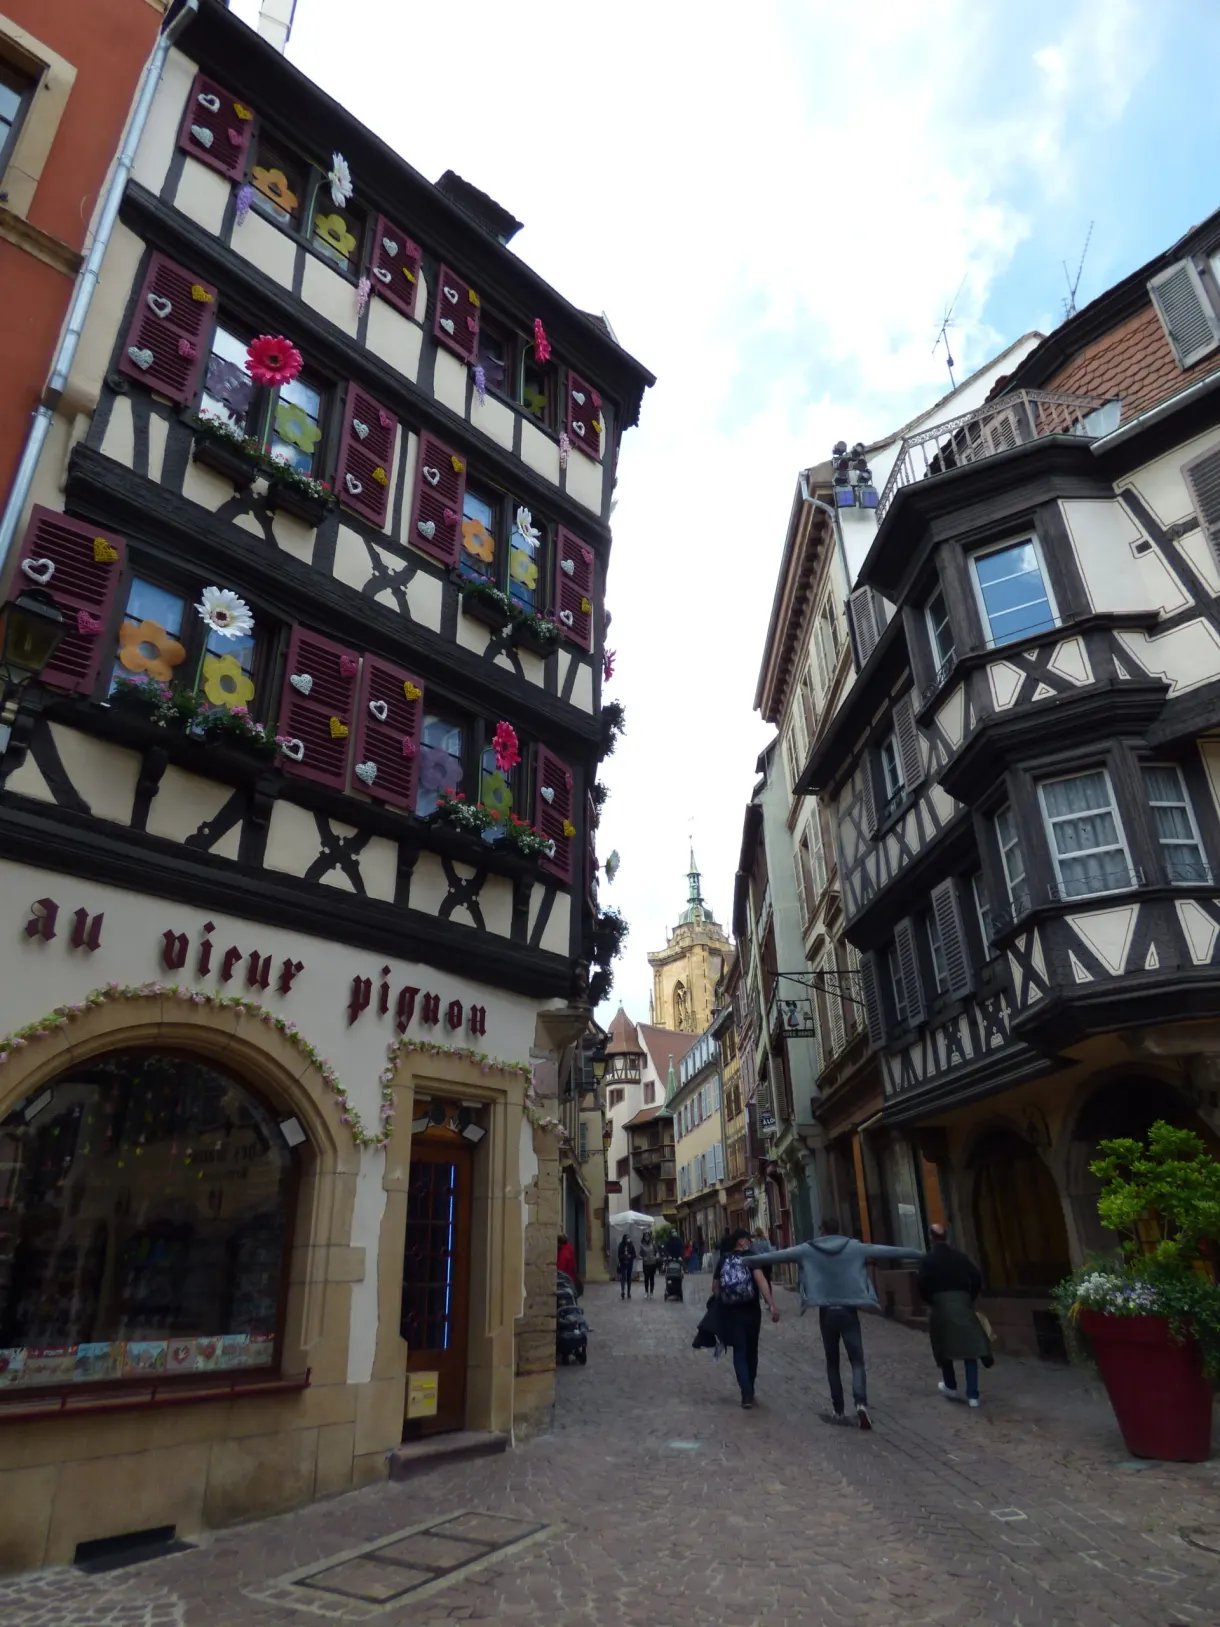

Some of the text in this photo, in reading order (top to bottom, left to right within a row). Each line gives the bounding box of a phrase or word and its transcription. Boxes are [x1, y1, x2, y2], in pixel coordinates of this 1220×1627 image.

[26, 898, 488, 1037] au vieux pignon
